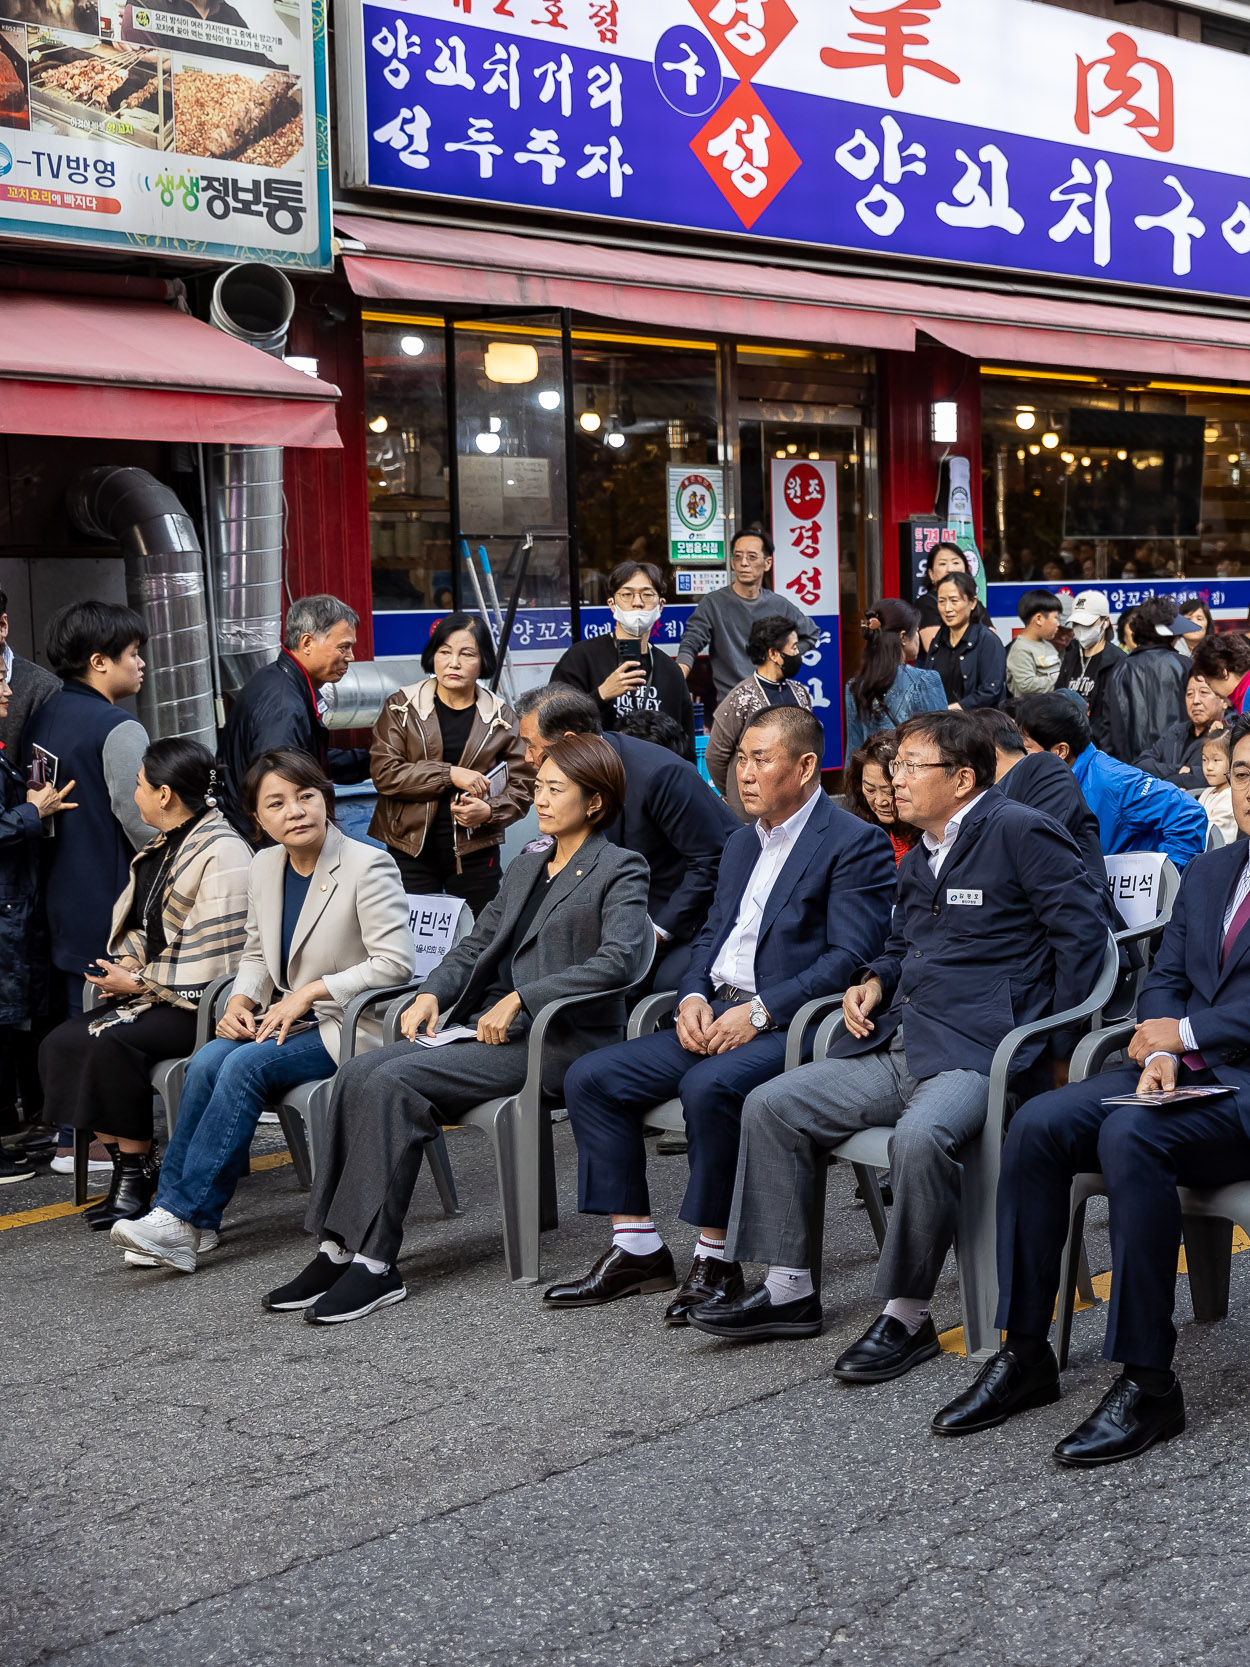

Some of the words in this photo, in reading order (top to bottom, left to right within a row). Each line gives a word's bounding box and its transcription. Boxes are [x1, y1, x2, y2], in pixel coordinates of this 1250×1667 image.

[170, 15, 189, 26] 방식이
[190, 19, 203, 30] 여러
[205, 22, 230, 35] 가지인데
[205, 32, 224, 43] 방식이
[233, 37, 253, 48] 꼬치가
[372, 18, 623, 127] 양꼬치거리
[373, 104, 634, 199] 선두주자
[7, 186, 62, 205] 꼬치요리에
[63, 192, 97, 210] 빠지다
[155, 161, 308, 235] 생생정보통
[786, 476, 822, 504] 원조
[677, 542, 719, 554] 모범음식점
[785, 520, 822, 606] 경성
